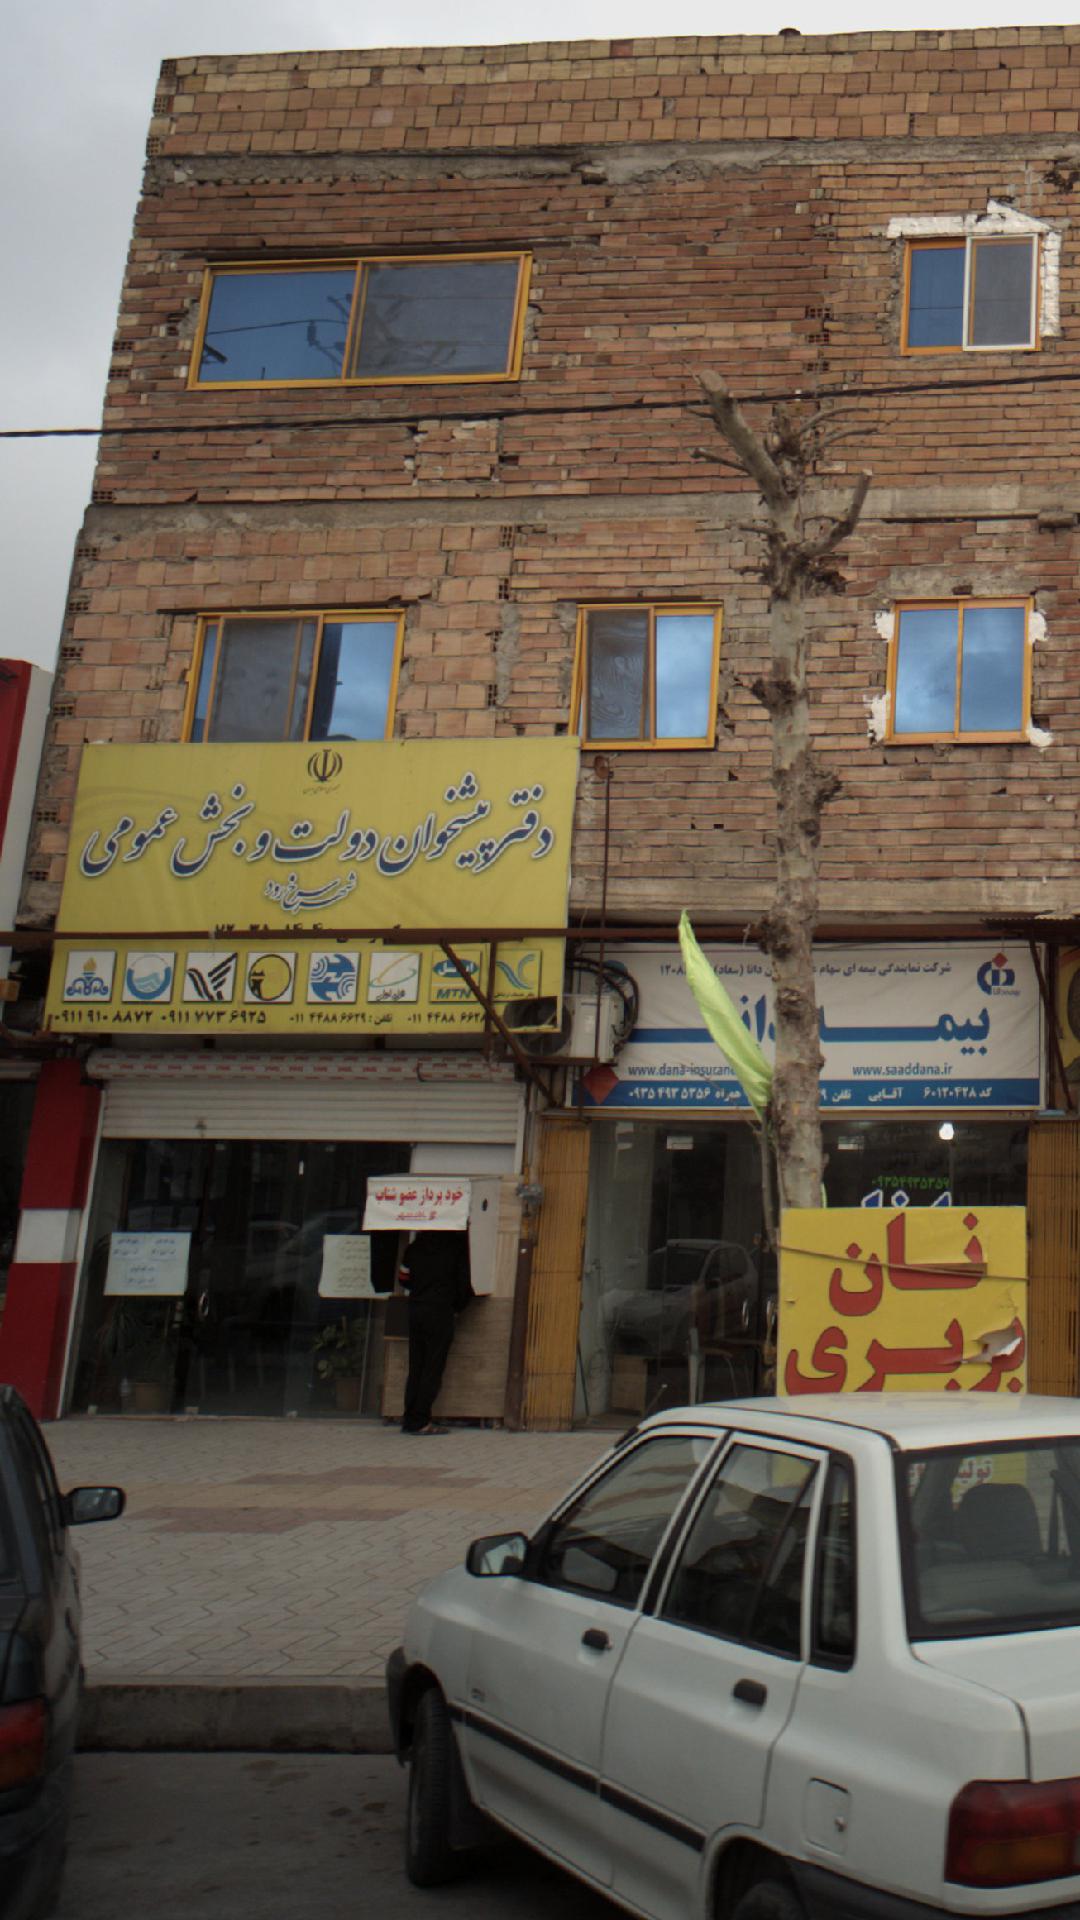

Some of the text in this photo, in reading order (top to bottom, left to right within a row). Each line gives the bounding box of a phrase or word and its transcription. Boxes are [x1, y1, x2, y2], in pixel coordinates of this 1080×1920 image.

[79, 772, 553, 878] دفتر پیشخوان دولت و بخش عمومی
[923, 961, 952, 976] شرکت
[436, 987, 472, 999] MTN
[819, 1005, 990, 1055] بیم
[852, 1062, 953, 1076] www.saaddana.ir
[398, 1187, 417, 1206] عضو
[828, 1212, 988, 1317] نان
[784, 1316, 1026, 1396] بربری
